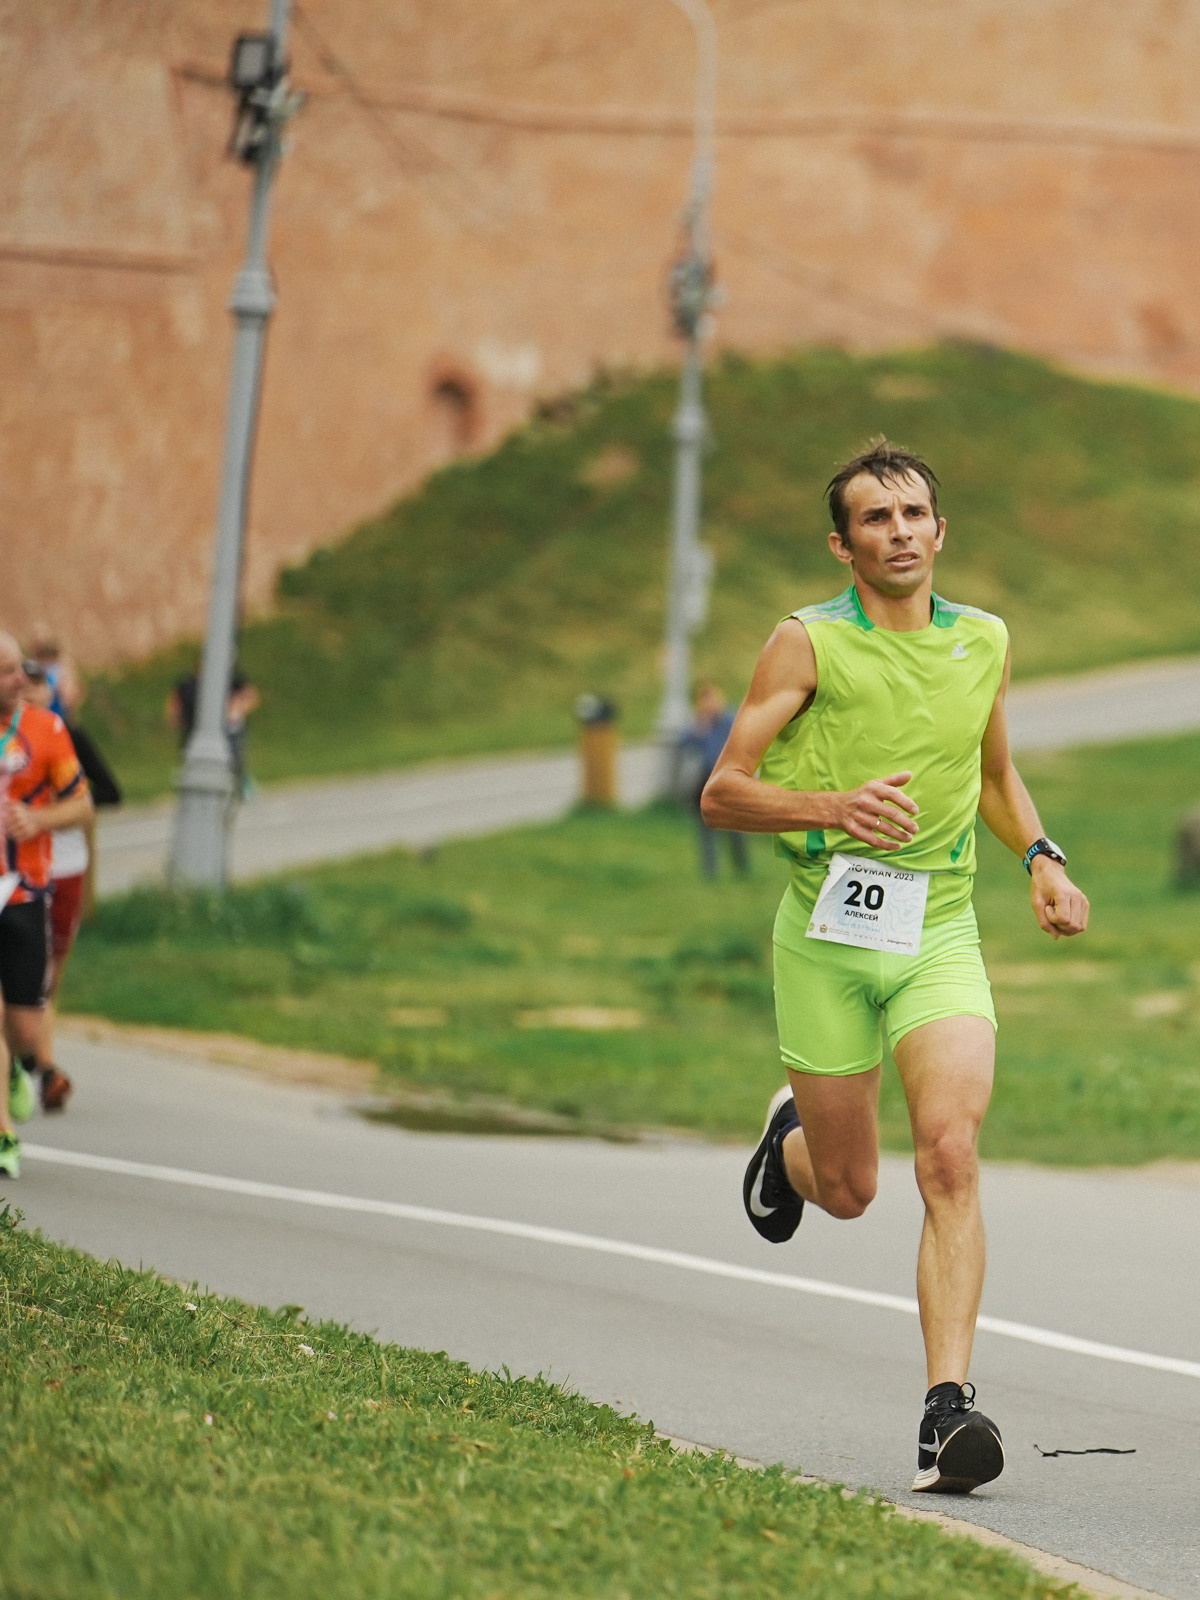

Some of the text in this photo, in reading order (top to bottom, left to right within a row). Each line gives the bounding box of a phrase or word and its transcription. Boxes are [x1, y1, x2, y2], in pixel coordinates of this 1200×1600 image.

[894, 872, 914, 881] 2023
[843, 880, 885, 911] 20
[844, 910, 878, 921] АЛЕКСЕЙ
